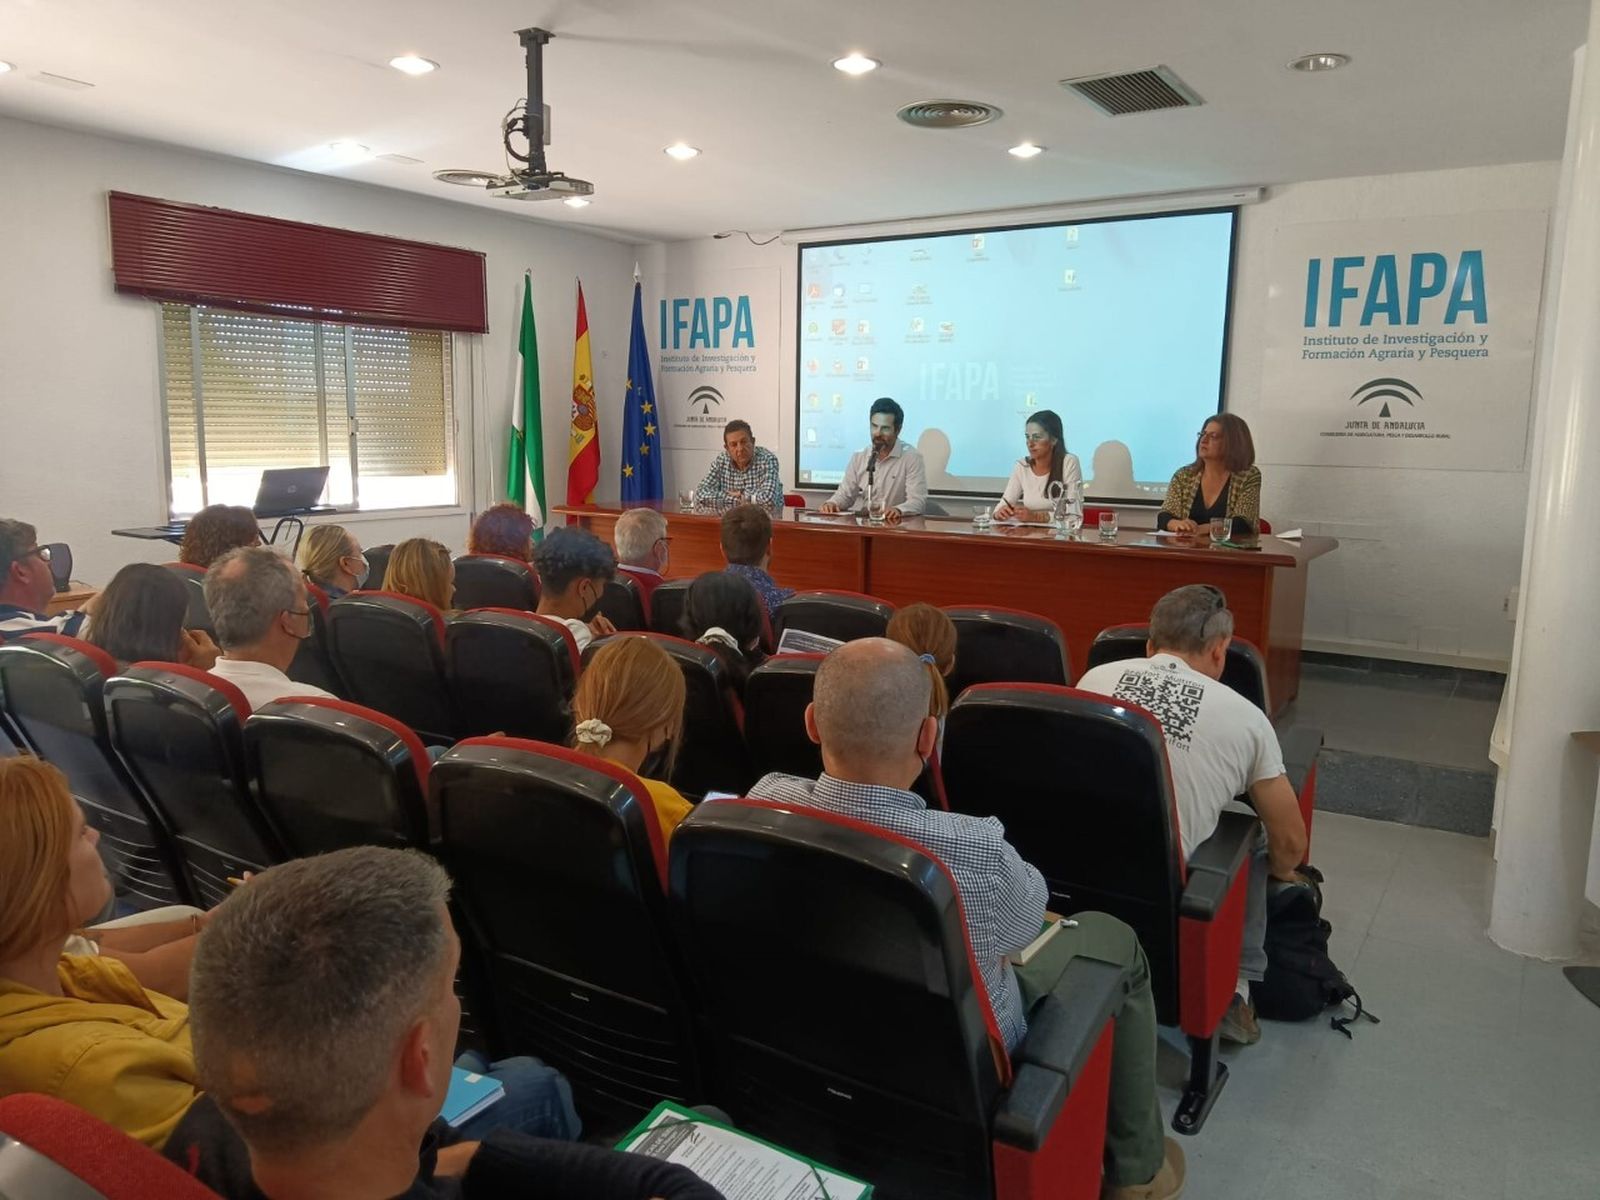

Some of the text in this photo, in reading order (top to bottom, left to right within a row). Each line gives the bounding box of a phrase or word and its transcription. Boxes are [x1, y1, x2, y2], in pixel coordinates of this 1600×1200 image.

[1304, 249, 1488, 328] IFAPA
[660, 295, 755, 349] IFAPA
[1303, 332, 1488, 347] Instituto de Investigación y
[1302, 348, 1489, 361] Formación Agraria y Pesquera
[919, 361, 1000, 401] IFAPA
[1345, 421, 1369, 430] JUNTA
[1372, 421, 1381, 430] DE
[1168, 739, 1190, 752] ifort
